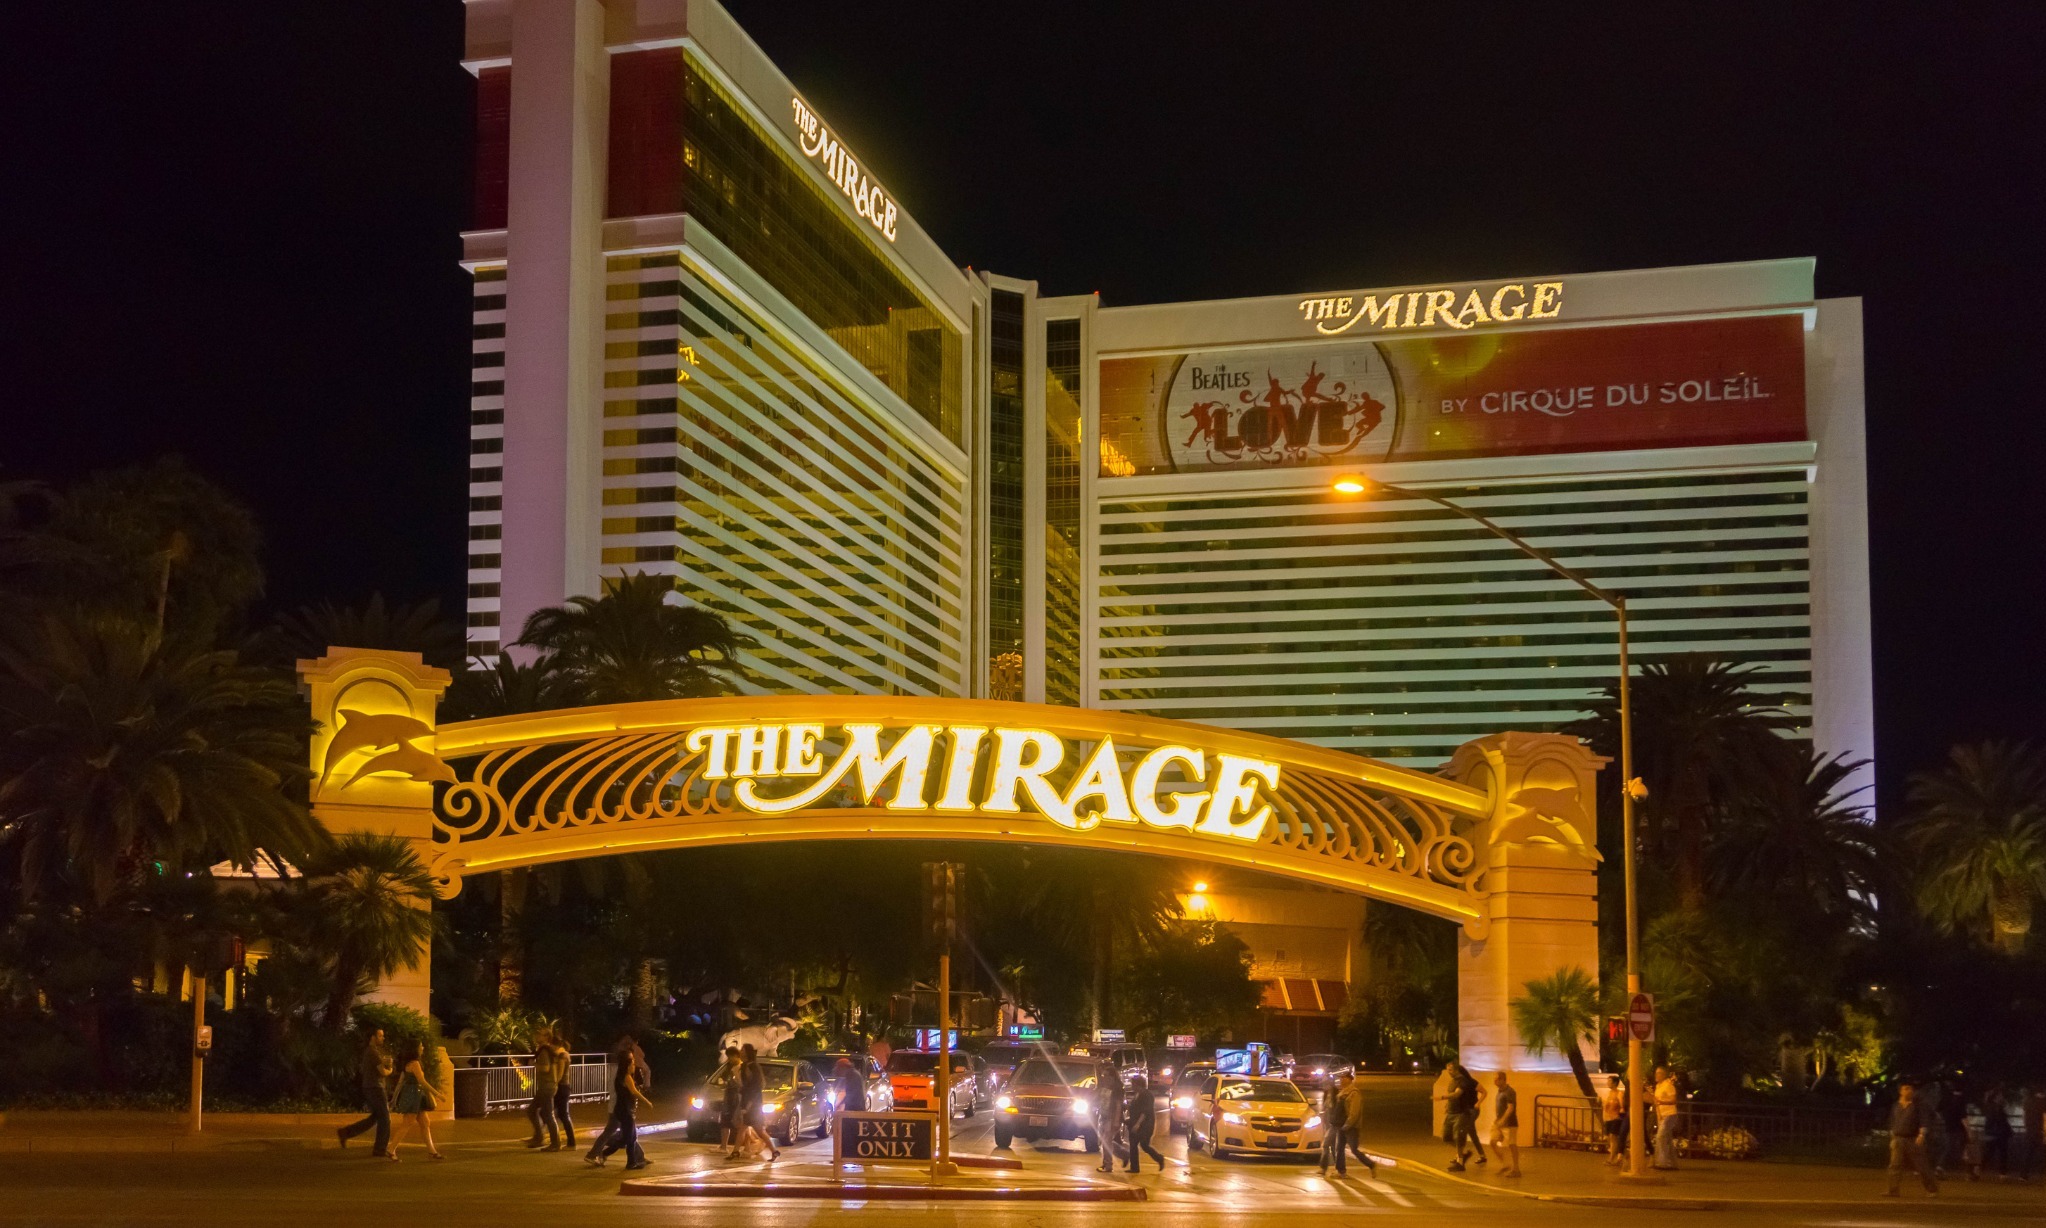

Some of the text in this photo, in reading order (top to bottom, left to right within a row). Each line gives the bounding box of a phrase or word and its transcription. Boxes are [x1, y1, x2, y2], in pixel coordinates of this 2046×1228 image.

[792, 97, 897, 242] THE MIRAGE
[1299, 281, 1564, 335] THE MIRAGE
[1191, 367, 1251, 391] BEATLES
[1441, 375, 1771, 417] BY CIRQUE DU SOLEIL
[1213, 400, 1350, 452] LOVE
[686, 722, 1281, 842] THE MIRAGE
[856, 1140, 917, 1158] ONLY
[857, 1120, 917, 1138] EXIT
